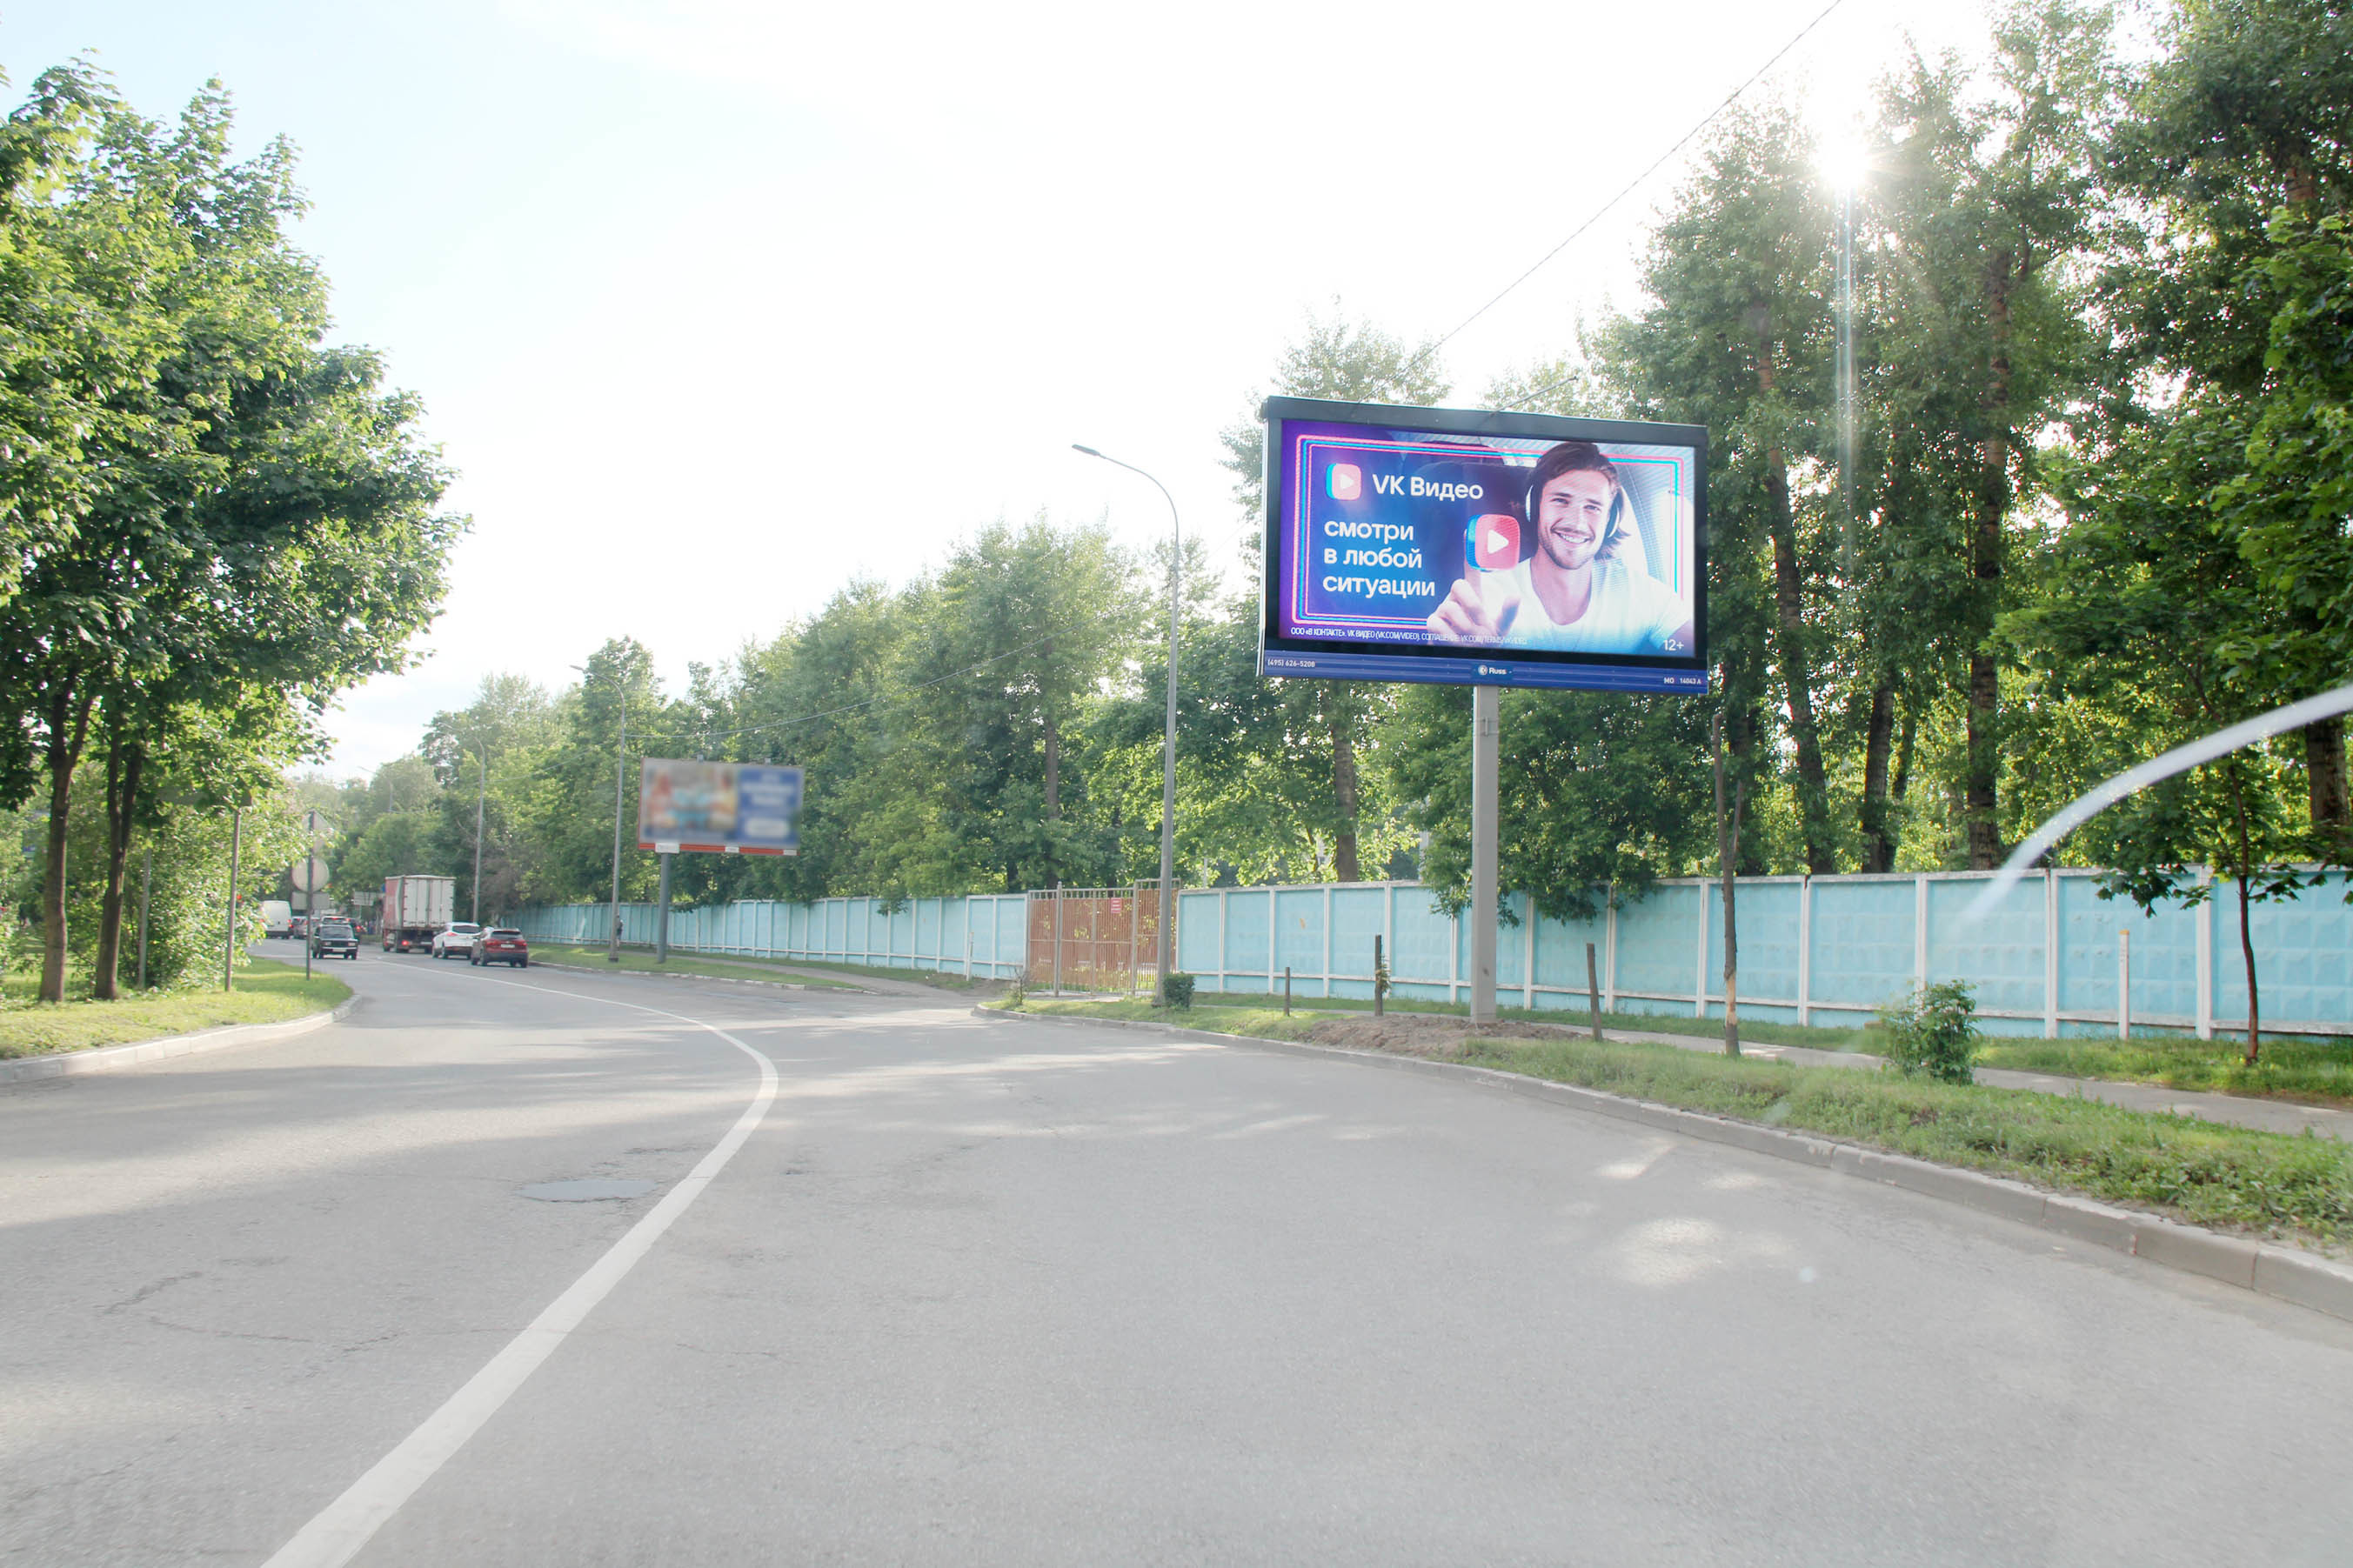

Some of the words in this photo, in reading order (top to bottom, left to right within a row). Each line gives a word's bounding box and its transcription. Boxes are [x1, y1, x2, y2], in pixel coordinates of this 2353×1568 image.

[1372, 474, 1405, 496] VK
[1410, 477, 1483, 502] Видео
[1324, 521, 1414, 544] смотри
[1324, 548, 1337, 564] в
[1342, 547, 1422, 568] любой
[1322, 576, 1435, 598] ситуации
[1663, 639, 1684, 651] 12+
